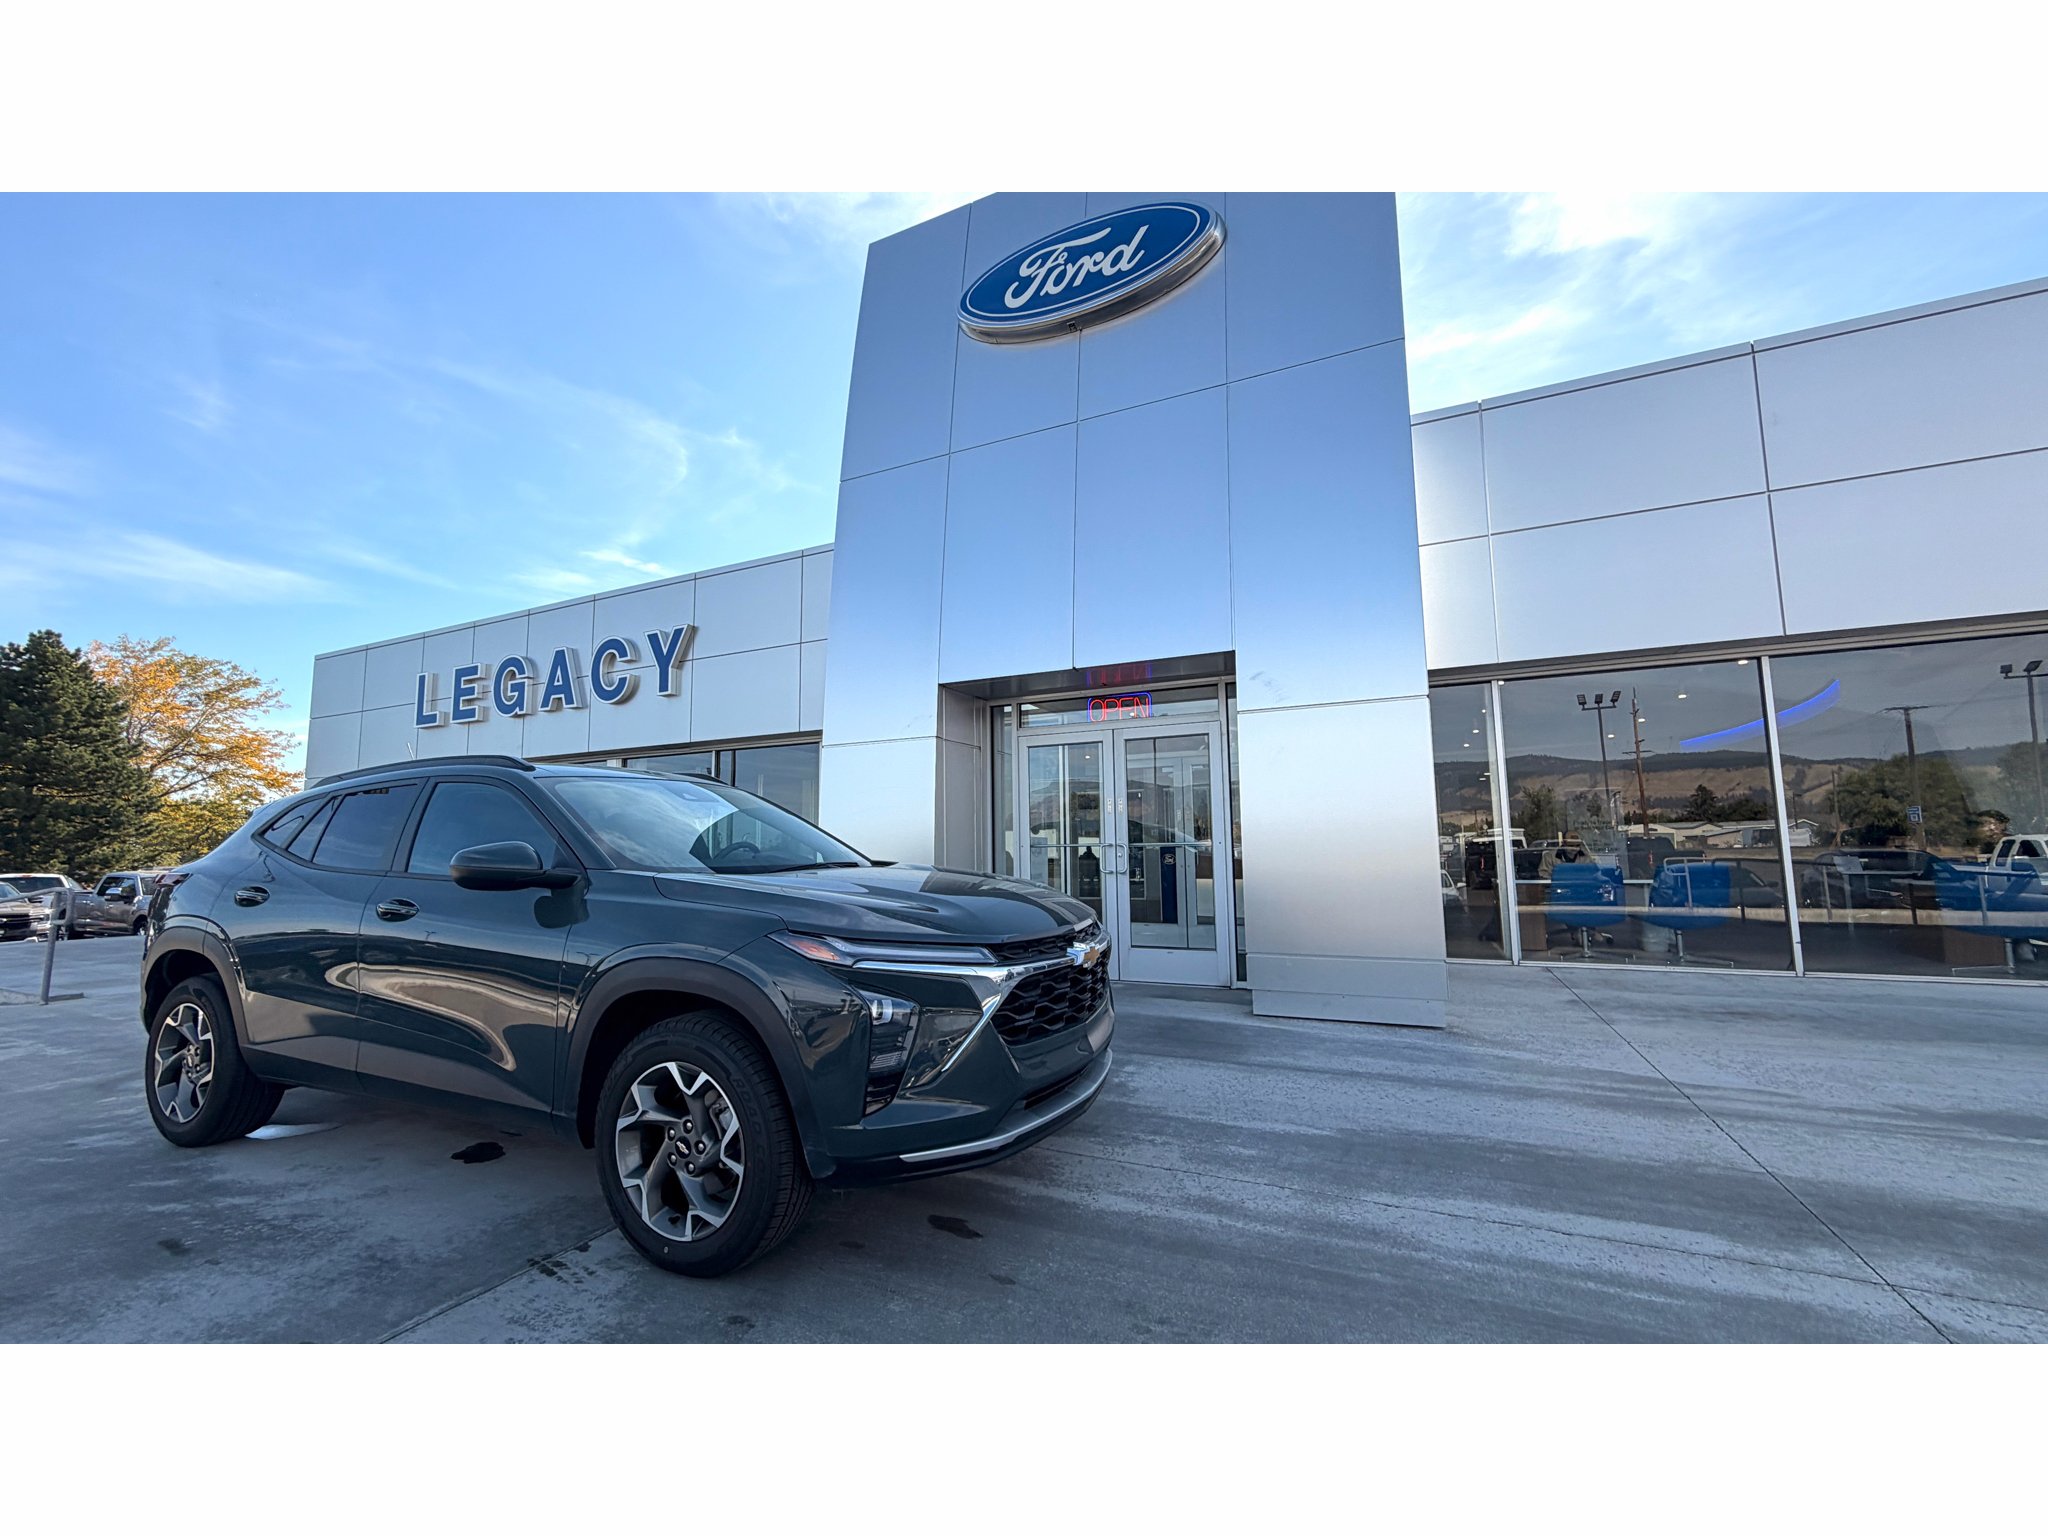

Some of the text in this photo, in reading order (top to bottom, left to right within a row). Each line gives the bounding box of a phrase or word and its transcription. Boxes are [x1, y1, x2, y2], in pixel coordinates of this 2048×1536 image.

[1005, 225, 1149, 308] Ford
[414, 624, 695, 729] LEGACY
[1089, 697, 1149, 722] OPEN
